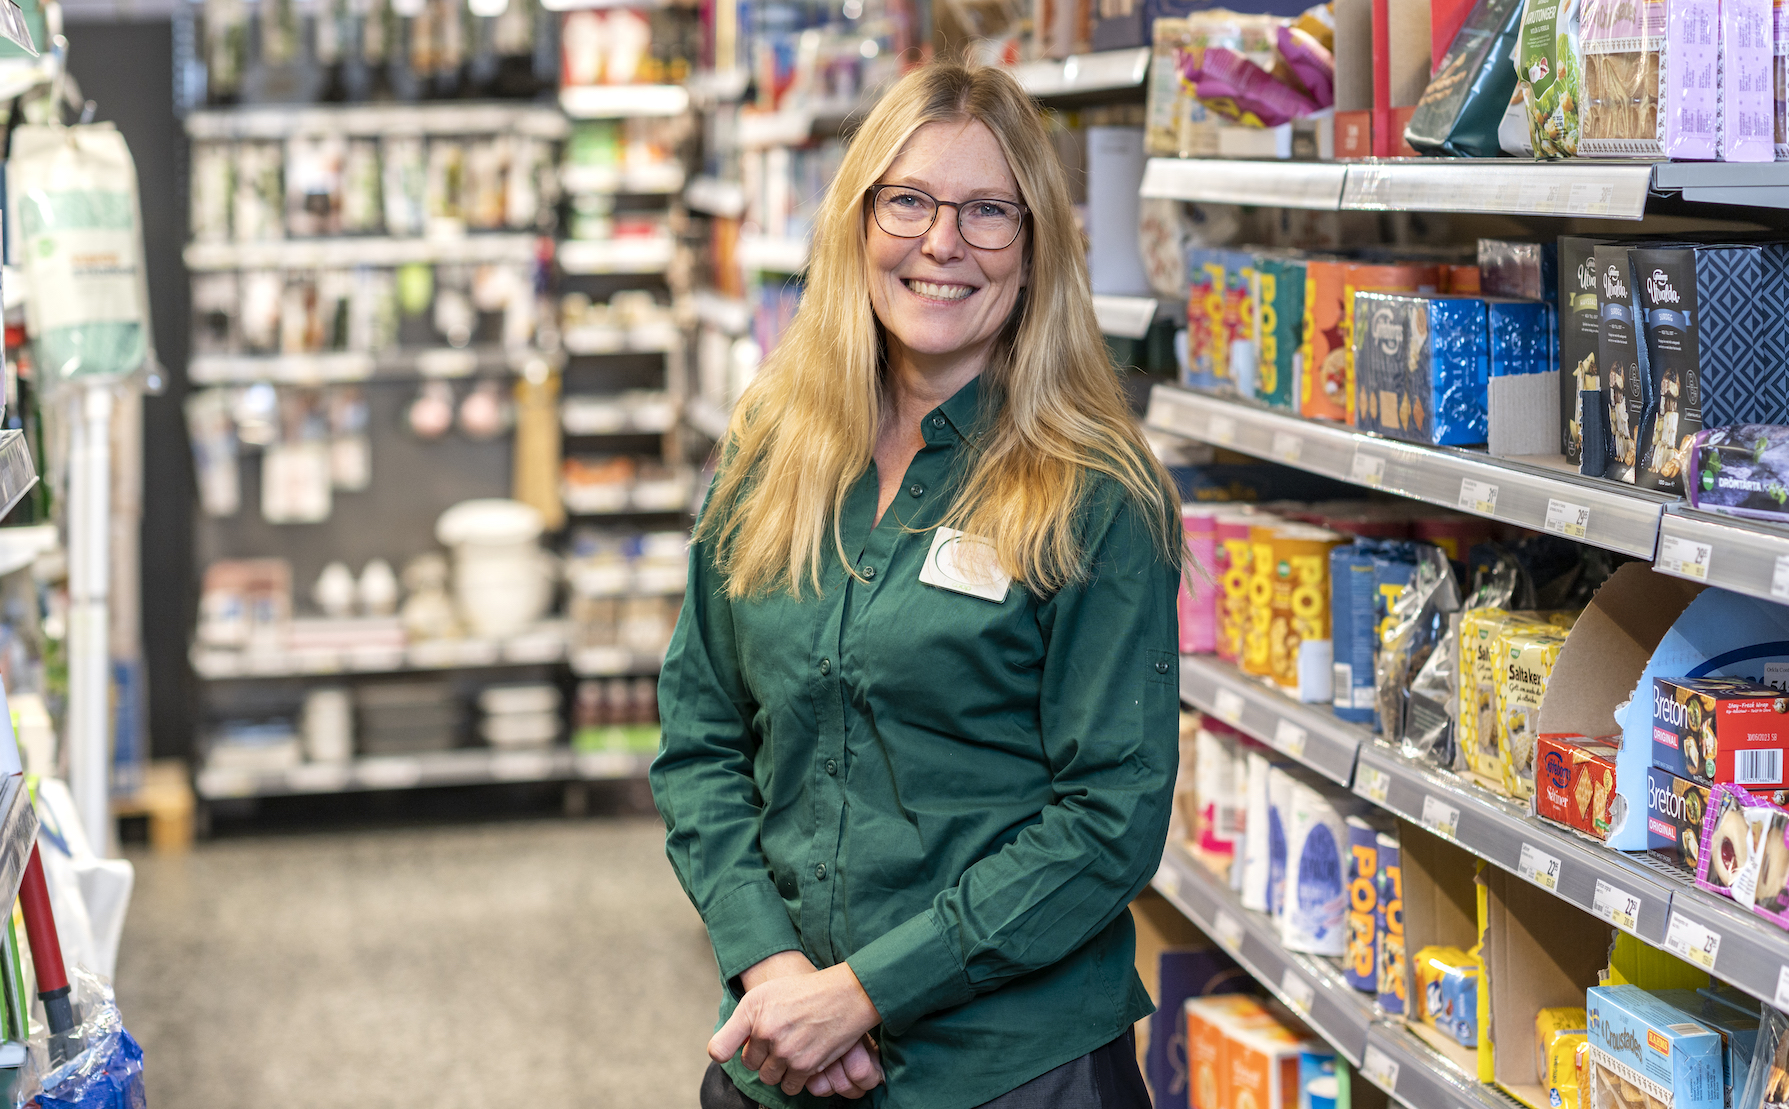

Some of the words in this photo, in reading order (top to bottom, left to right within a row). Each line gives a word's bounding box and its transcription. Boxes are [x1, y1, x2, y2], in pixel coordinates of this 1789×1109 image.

[1653, 685, 1688, 729] Breton
[1653, 728, 1678, 747] ORIGINAL
[1648, 775, 1687, 822] Breton
[1648, 819, 1676, 839] ORIGINAL
[1352, 844, 1377, 978] POPP
